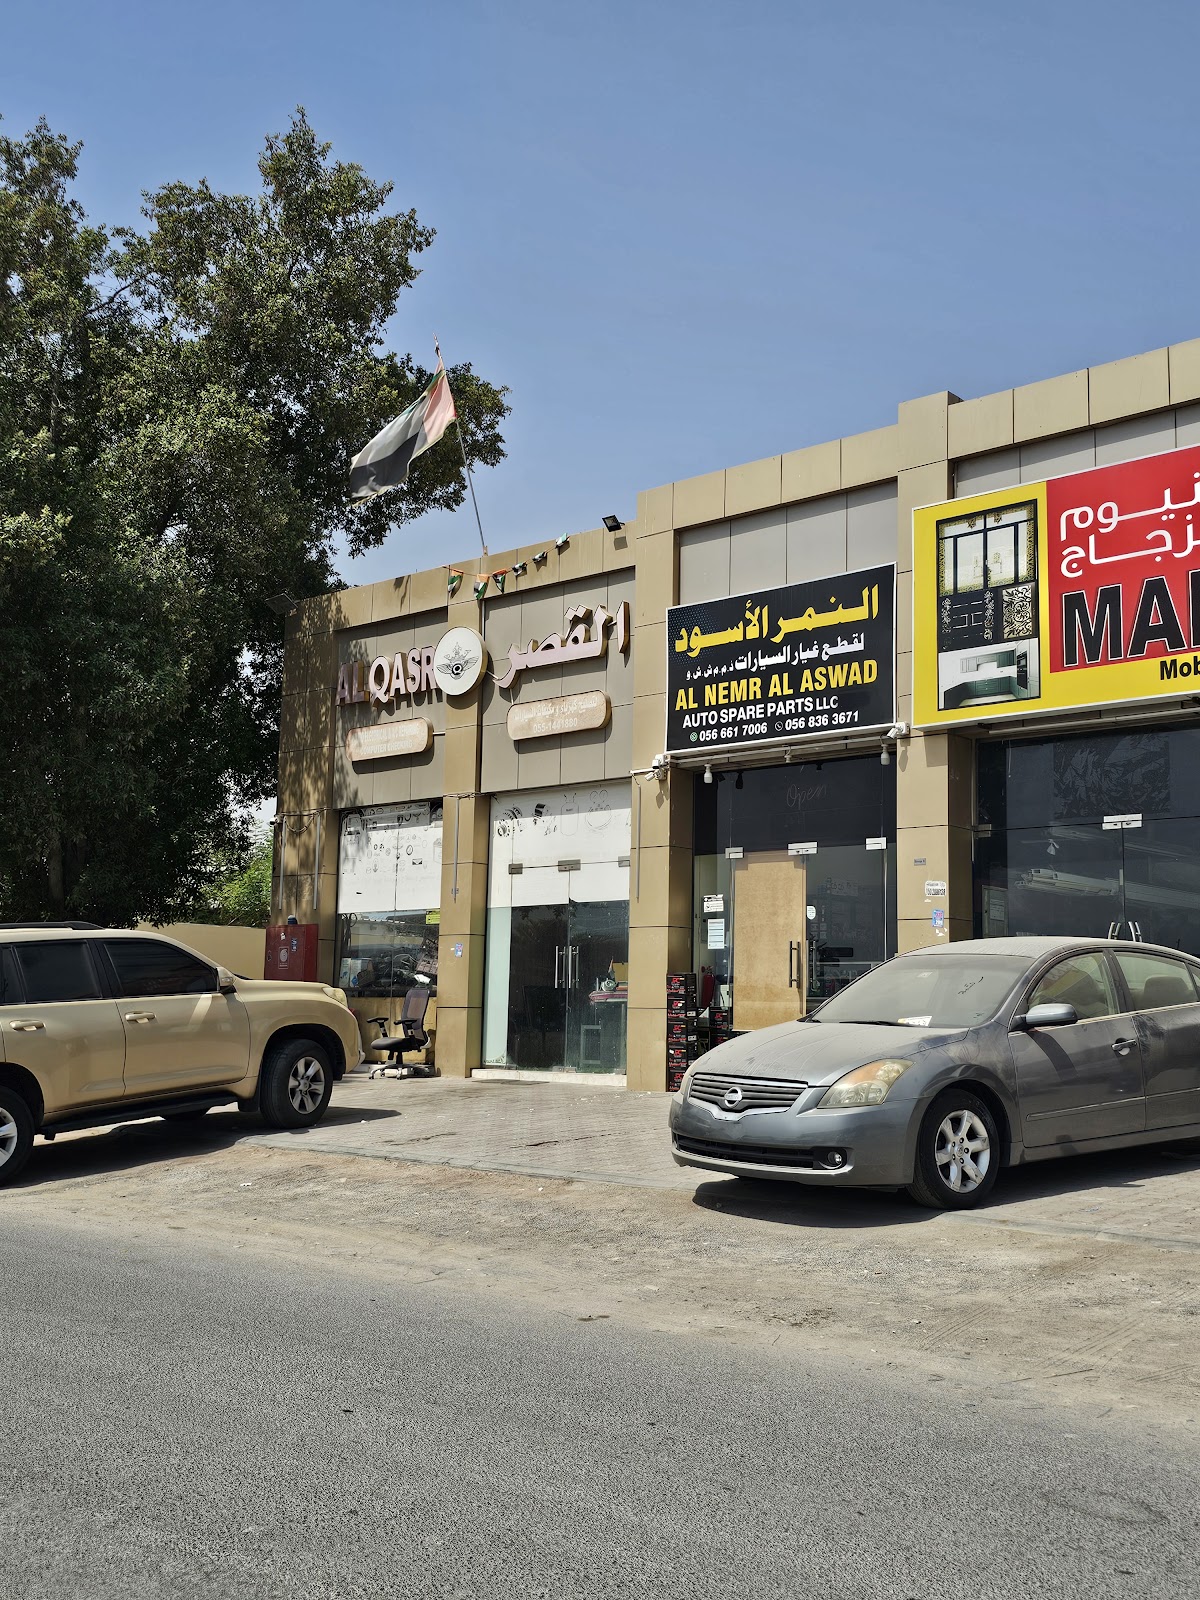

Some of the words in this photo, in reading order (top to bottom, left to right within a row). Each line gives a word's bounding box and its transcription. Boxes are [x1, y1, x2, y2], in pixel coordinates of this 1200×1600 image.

[674, 599, 769, 658] الأسود
[770, 583, 879, 643] النمر
[492, 600, 631, 689] القصر
[734, 644, 791, 672] السيارات
[791, 640, 819, 665] غيار
[821, 632, 864, 661] لقطع
[675, 687, 698, 711] AL
[704, 677, 762, 707] NEMR
[768, 672, 794, 698] AL
[799, 659, 878, 693] ASWAD
[682, 710, 718, 729] AUTO
[719, 704, 765, 723] SPARE
[767, 697, 814, 717] PARTS
[815, 695, 839, 711] LLC
[699, 729, 718, 742] 056
[720, 725, 739, 738] 661
[742, 722, 768, 736] 7006
[784, 717, 806, 731] 056
[808, 714, 829, 728] 836
[831, 710, 859, 725] 3671
